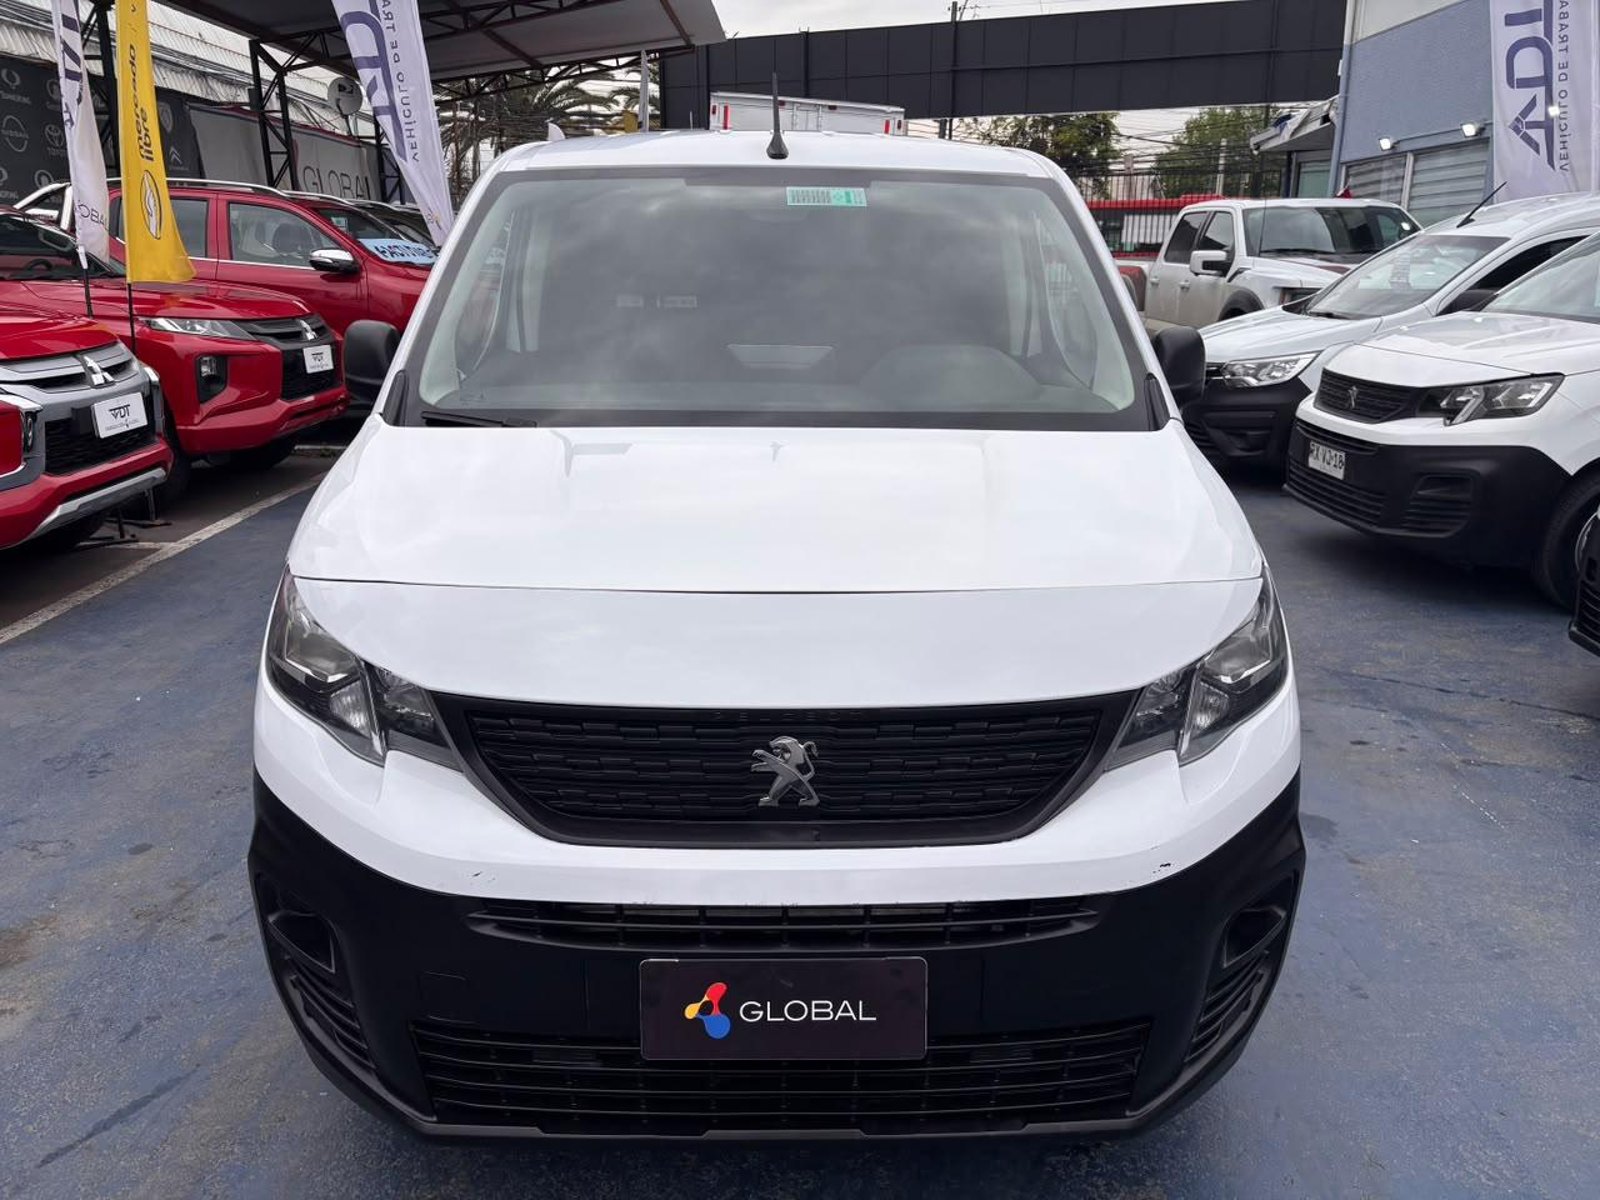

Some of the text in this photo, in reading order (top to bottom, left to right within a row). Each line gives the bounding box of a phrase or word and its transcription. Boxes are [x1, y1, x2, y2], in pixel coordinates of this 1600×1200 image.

[128, 44, 145, 159] mercado
[139, 108, 154, 162] libre
[739, 1000, 877, 1022] GLOBAL
